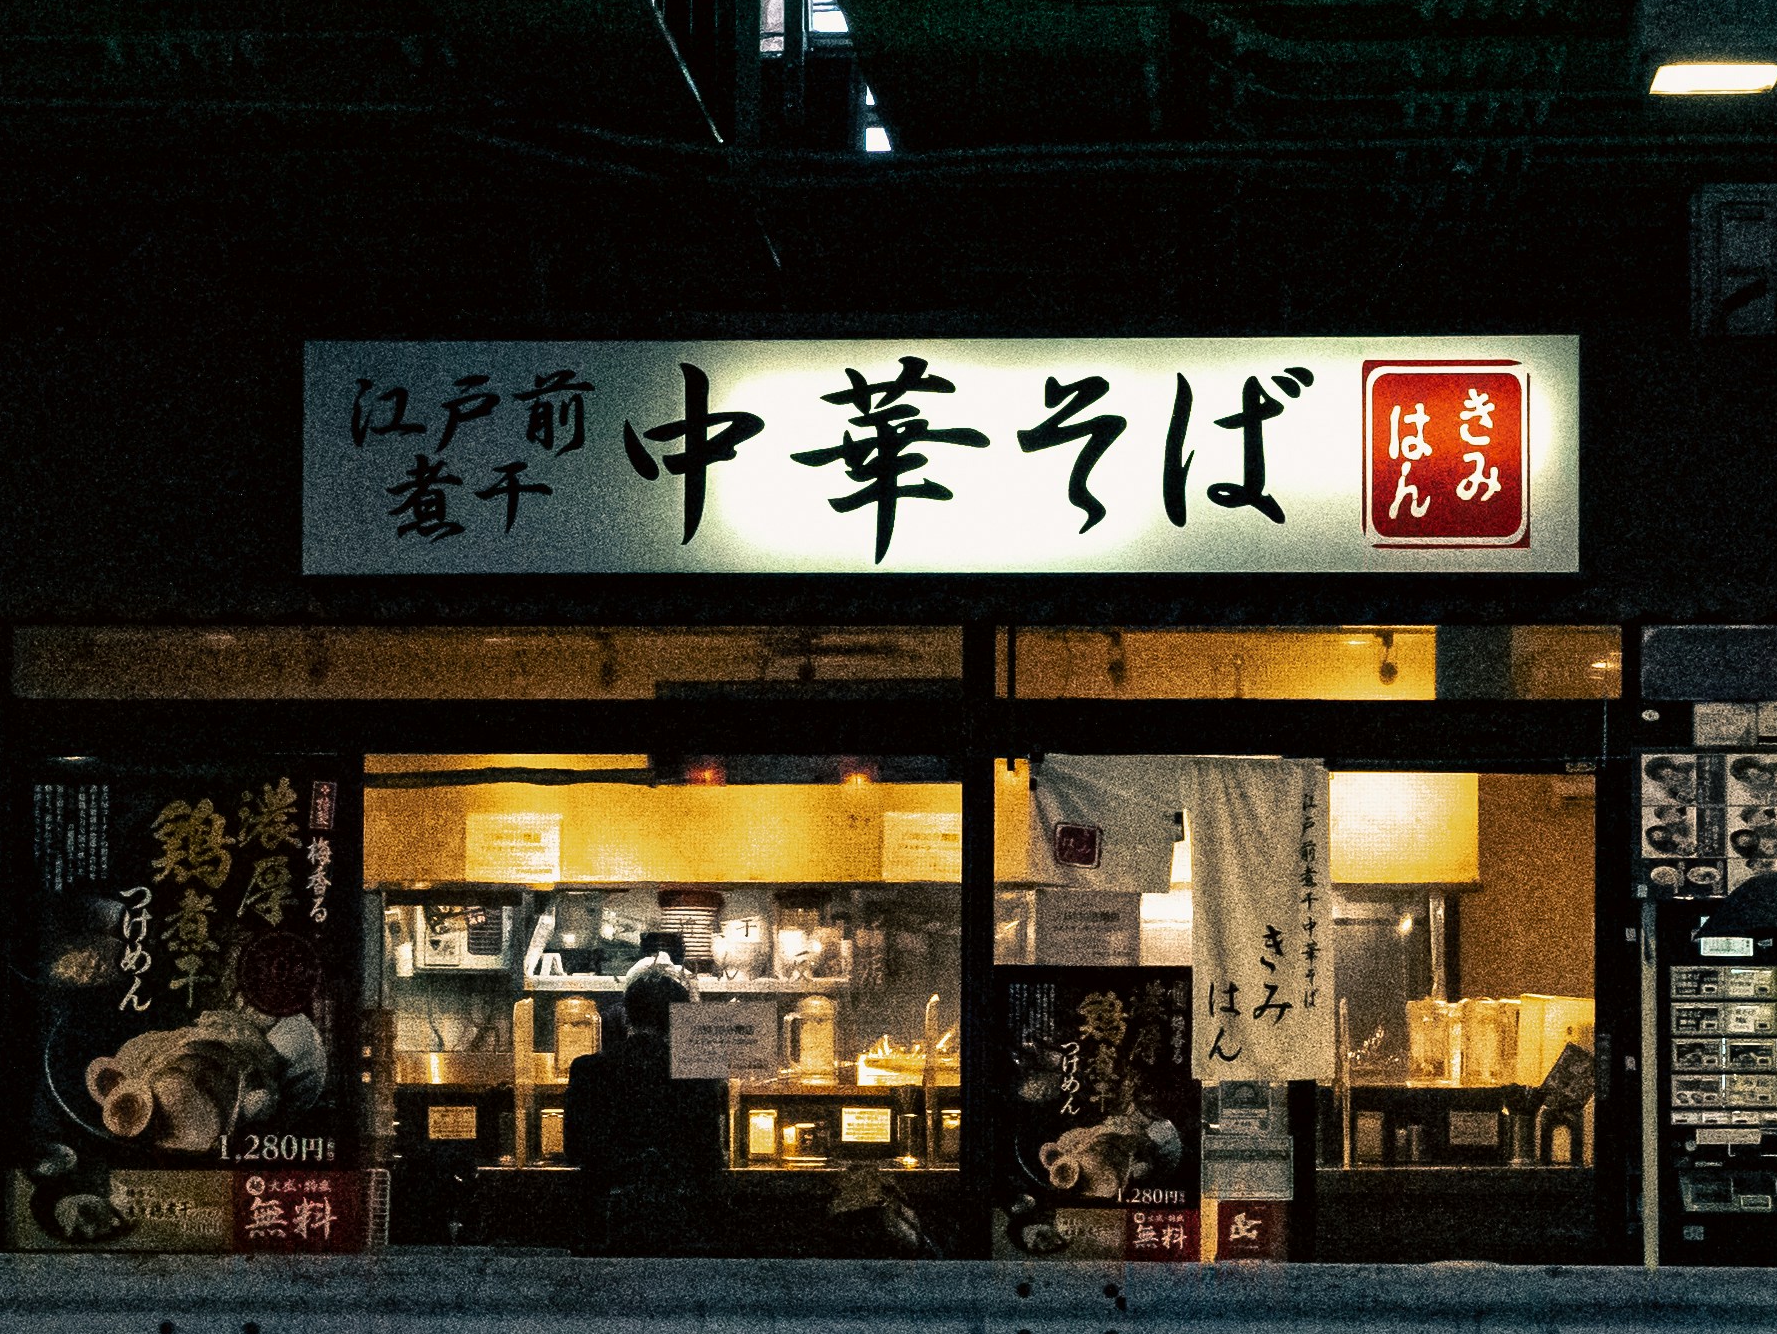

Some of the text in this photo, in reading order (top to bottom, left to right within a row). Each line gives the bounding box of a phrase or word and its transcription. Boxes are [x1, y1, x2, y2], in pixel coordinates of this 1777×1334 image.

[350, 370, 595, 455] 江戸前
[1456, 388, 1502, 501] きみ
[386, 457, 553, 538] 煮干
[622, 357, 1314, 564] 中華そば
[1388, 402, 1433, 519] はん
[237, 776, 303, 926] 濃厚
[306, 837, 334, 923] 梅香る
[150, 799, 235, 1008] 鶏煮干
[119, 885, 153, 1011] つけめん
[1252, 924, 1294, 1025] きみ
[1208, 981, 1243, 1064] はん
[1060, 1040, 1082, 1116] つけめん
[218, 1133, 324, 1161] 1,280円
[244, 1196, 338, 1240] 無料
[1133, 1222, 1188, 1251] 無料
